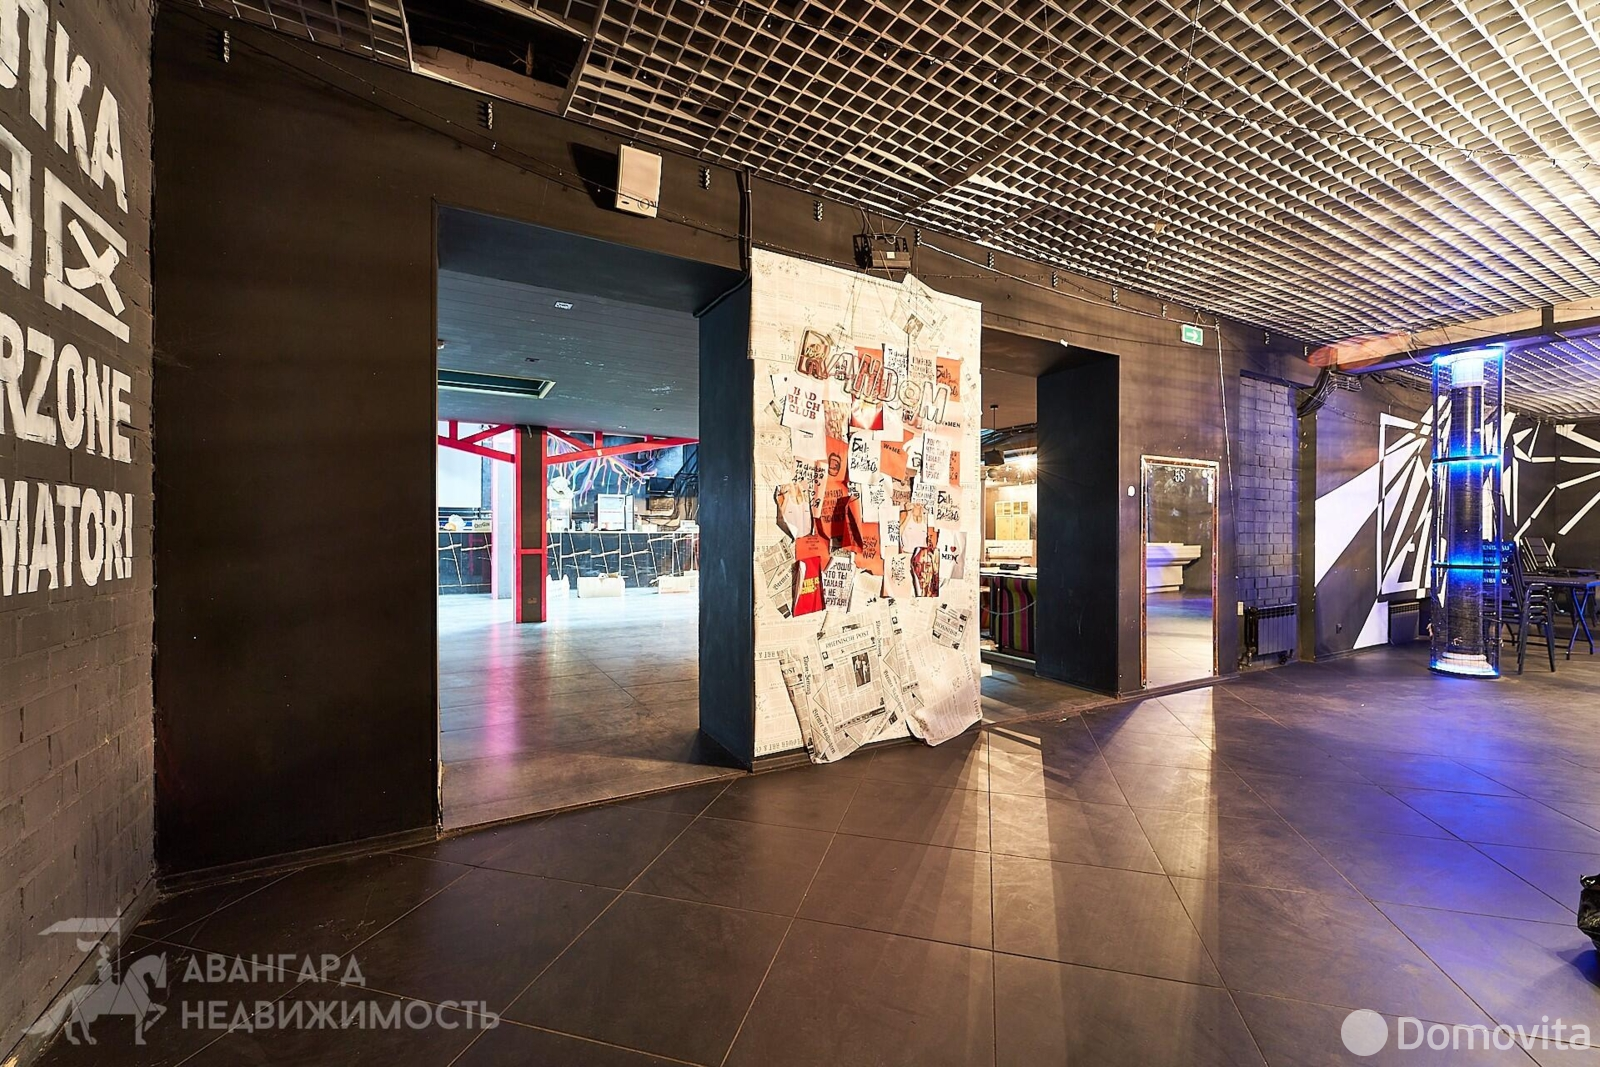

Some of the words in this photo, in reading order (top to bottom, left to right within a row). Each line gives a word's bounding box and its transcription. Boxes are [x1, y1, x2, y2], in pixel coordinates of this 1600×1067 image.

[795, 326, 949, 425] RANDOM
[788, 393, 820, 412] BICH
[789, 404, 816, 420] CLUB
[856, 630, 869, 640] POST
